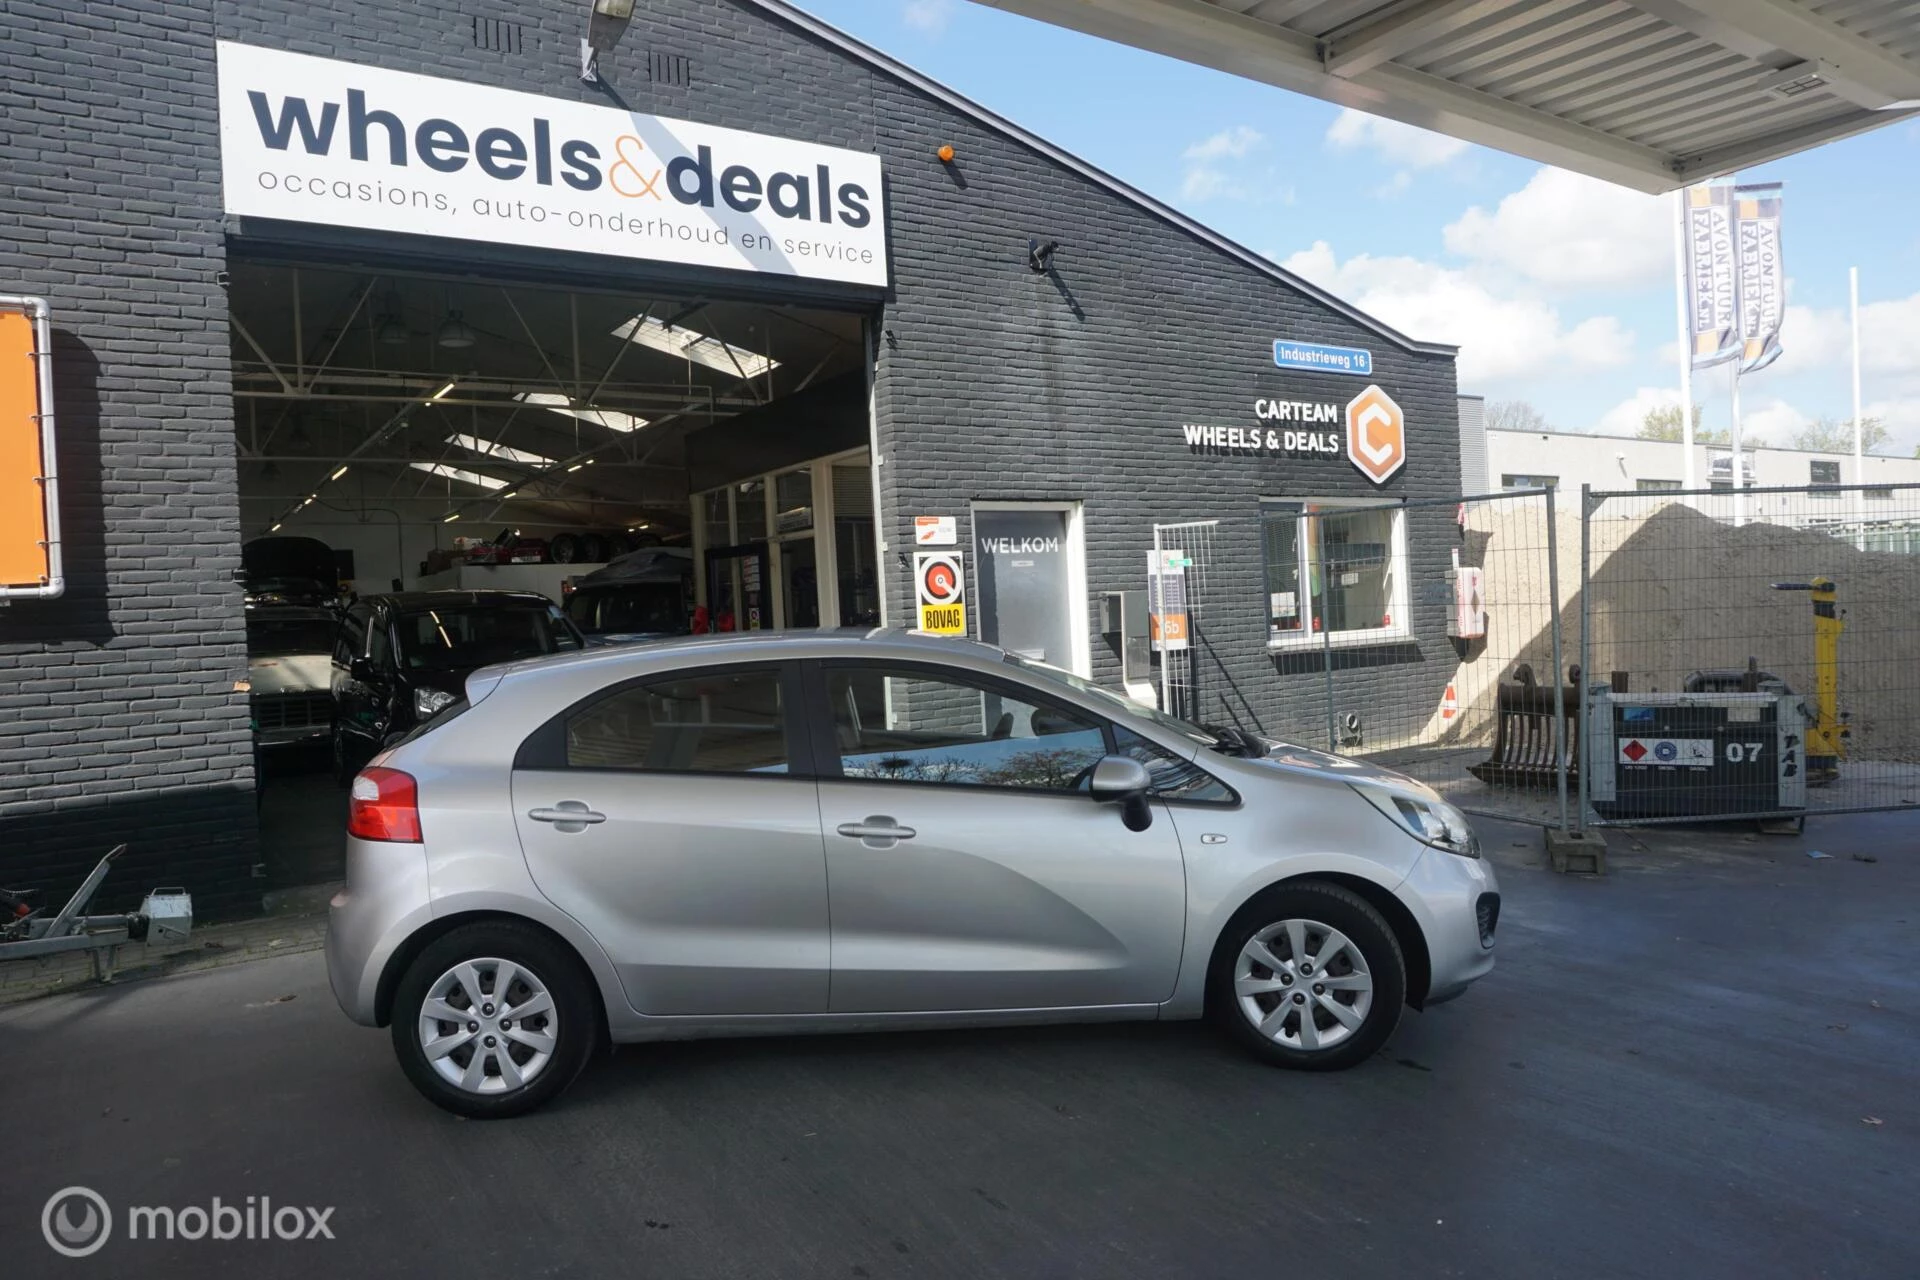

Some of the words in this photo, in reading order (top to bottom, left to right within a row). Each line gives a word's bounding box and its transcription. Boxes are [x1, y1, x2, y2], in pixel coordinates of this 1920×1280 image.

[247, 88, 872, 229] wheels&deals
[258, 170, 457, 215] occasions,
[472, 196, 729, 247] auto-onderhoud
[740, 230, 772, 253] en
[784, 238, 873, 264] service
[1712, 212, 1732, 325] AVONTUUR
[1760, 225, 1776, 332] AVONTUUR
[1281, 347, 1350, 368] Industrieweg
[1353, 354, 1366, 368] 16
[1255, 399, 1338, 423] CARTEAM
[1183, 425, 1261, 448] WHEELS
[1266, 430, 1279, 449] &
[1284, 431, 1339, 452] DEALS
[981, 537, 1059, 554] WELKOM
[925, 609, 960, 630] BOVAG
[1726, 743, 1763, 762] 07
